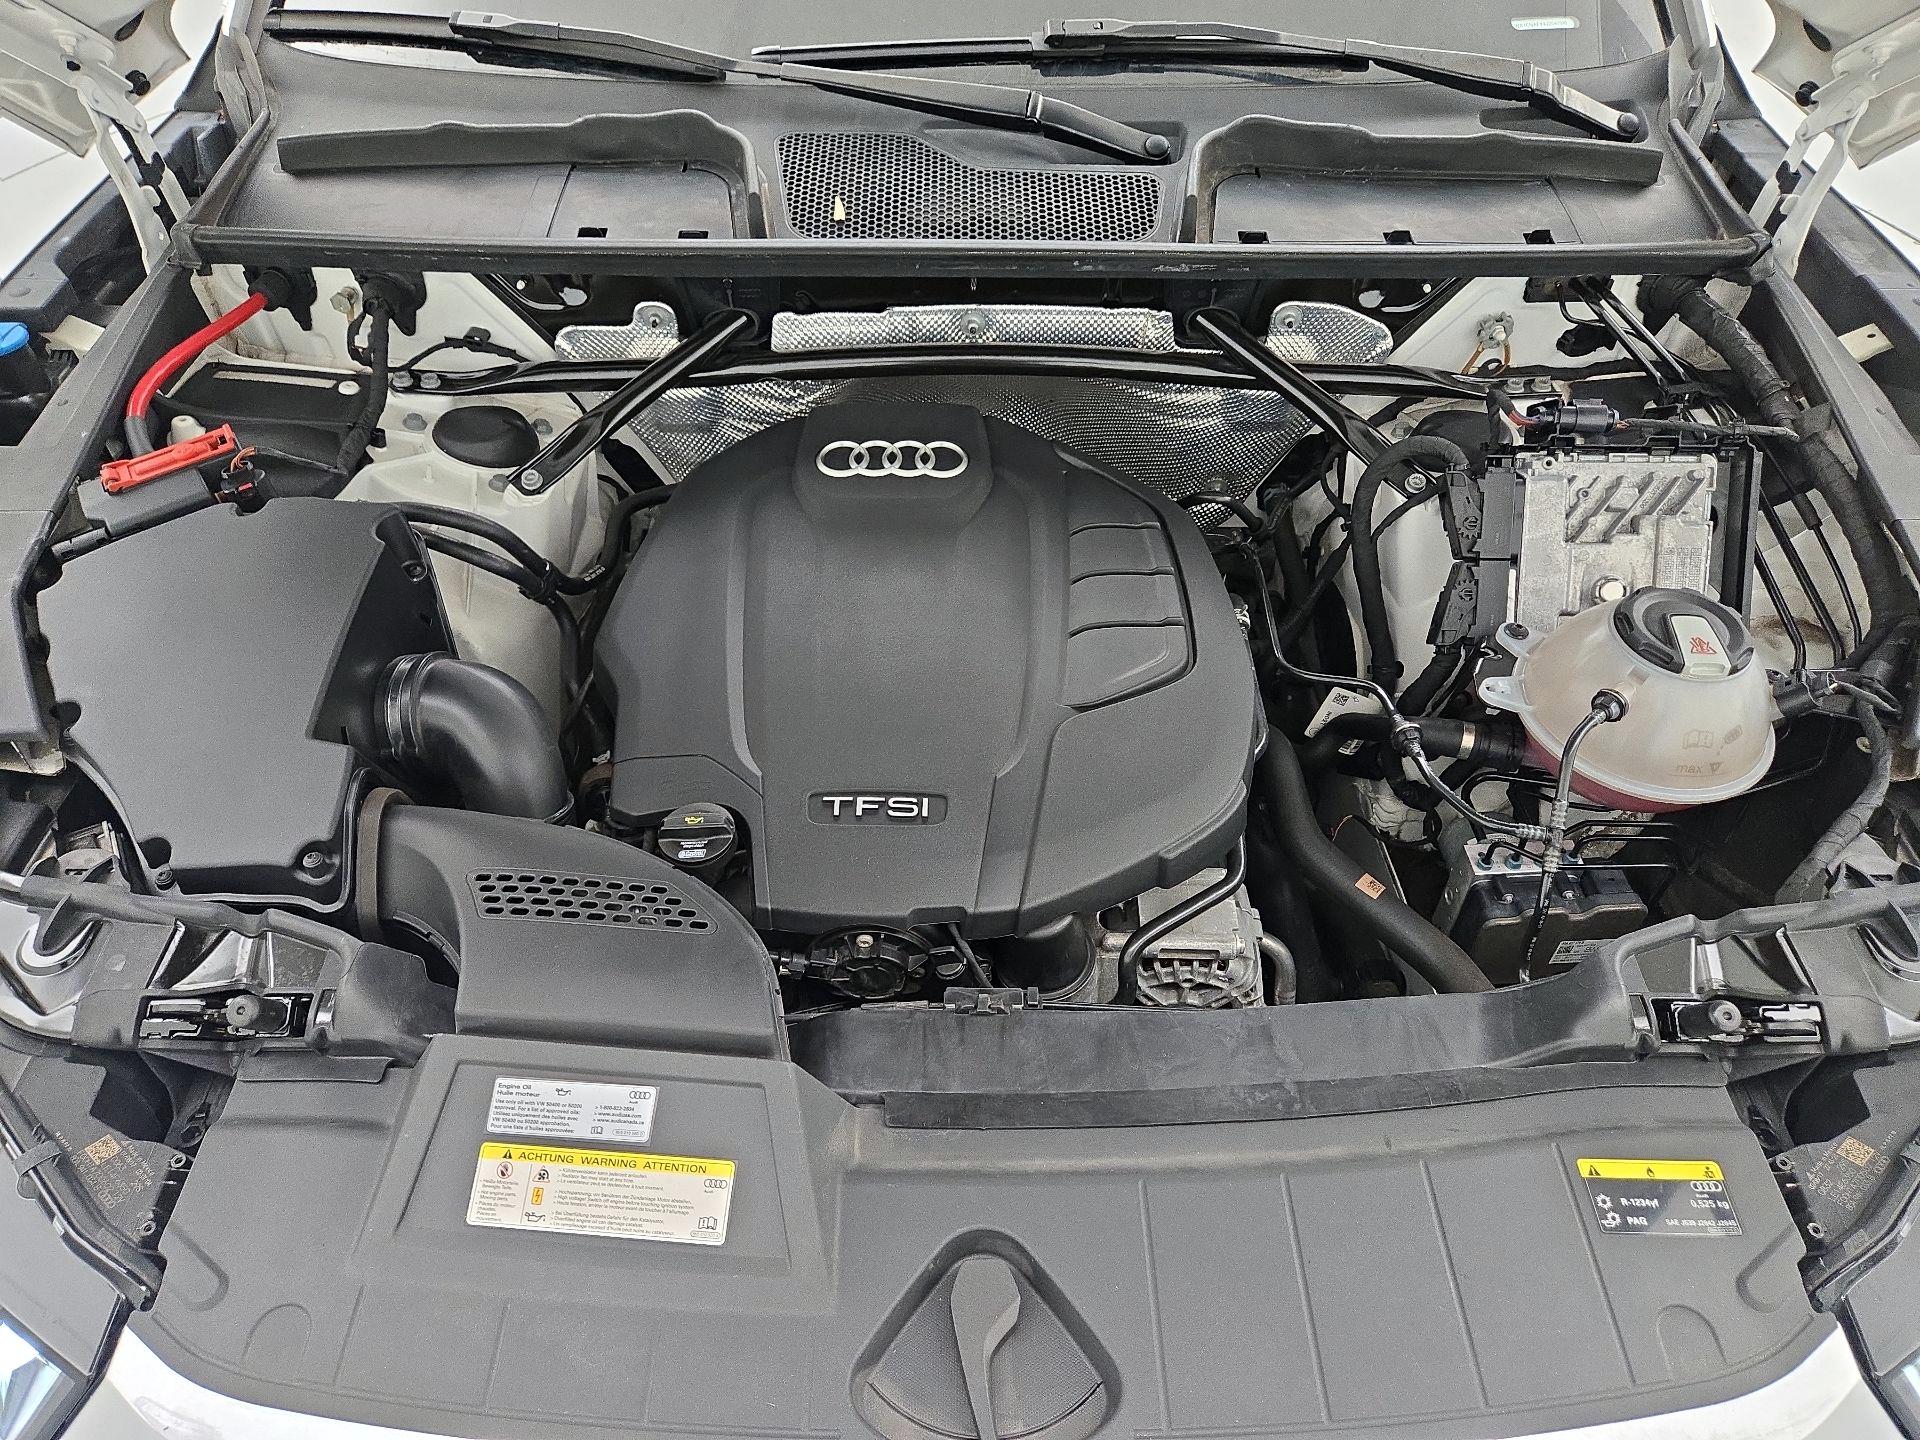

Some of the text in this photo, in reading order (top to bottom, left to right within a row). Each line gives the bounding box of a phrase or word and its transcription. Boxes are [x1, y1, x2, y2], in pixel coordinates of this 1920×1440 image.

[1677, 765, 1703, 773] max
[823, 797, 928, 817] TFSI
[518, 1151, 707, 1174] ACHTUNG WARNING ATTENTION
[1620, 1197, 1729, 1210] R-1234yf 0,525 kg
[1626, 1216, 1648, 1226] PAG
